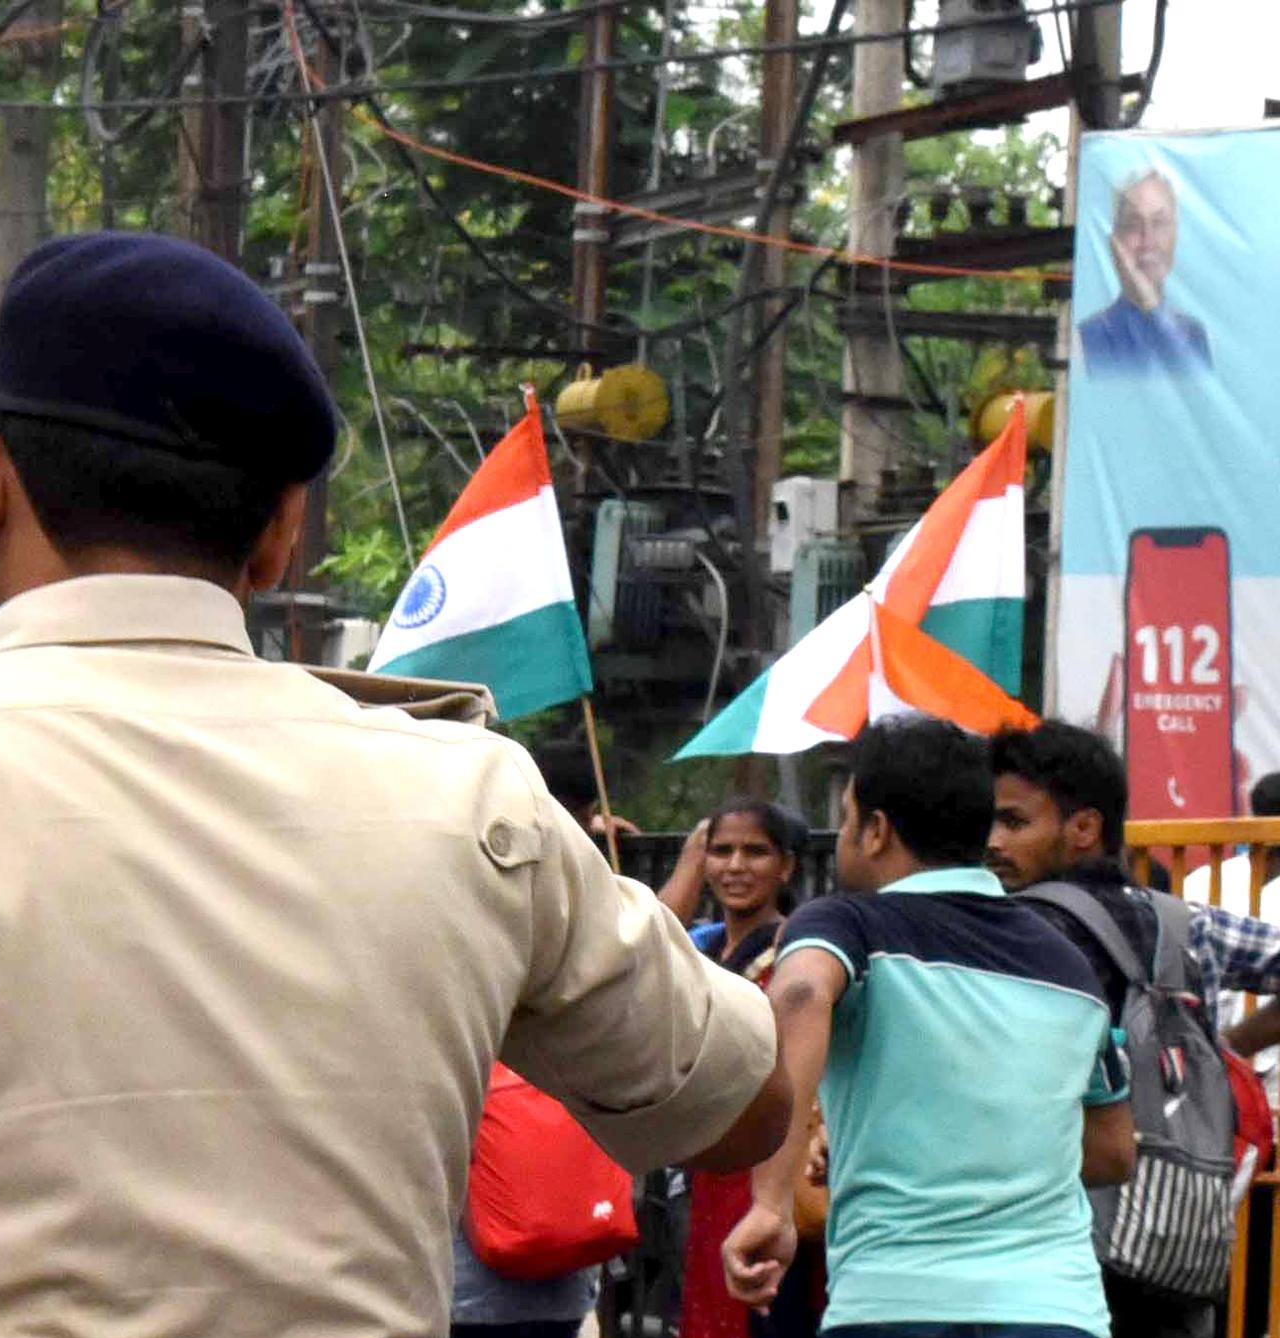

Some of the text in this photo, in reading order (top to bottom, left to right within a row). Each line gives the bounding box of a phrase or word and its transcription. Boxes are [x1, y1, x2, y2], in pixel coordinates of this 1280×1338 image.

[1135, 624, 1221, 685] 112
[1133, 693, 1222, 711] EMERGENCY
[1157, 714, 1197, 733] CALL
